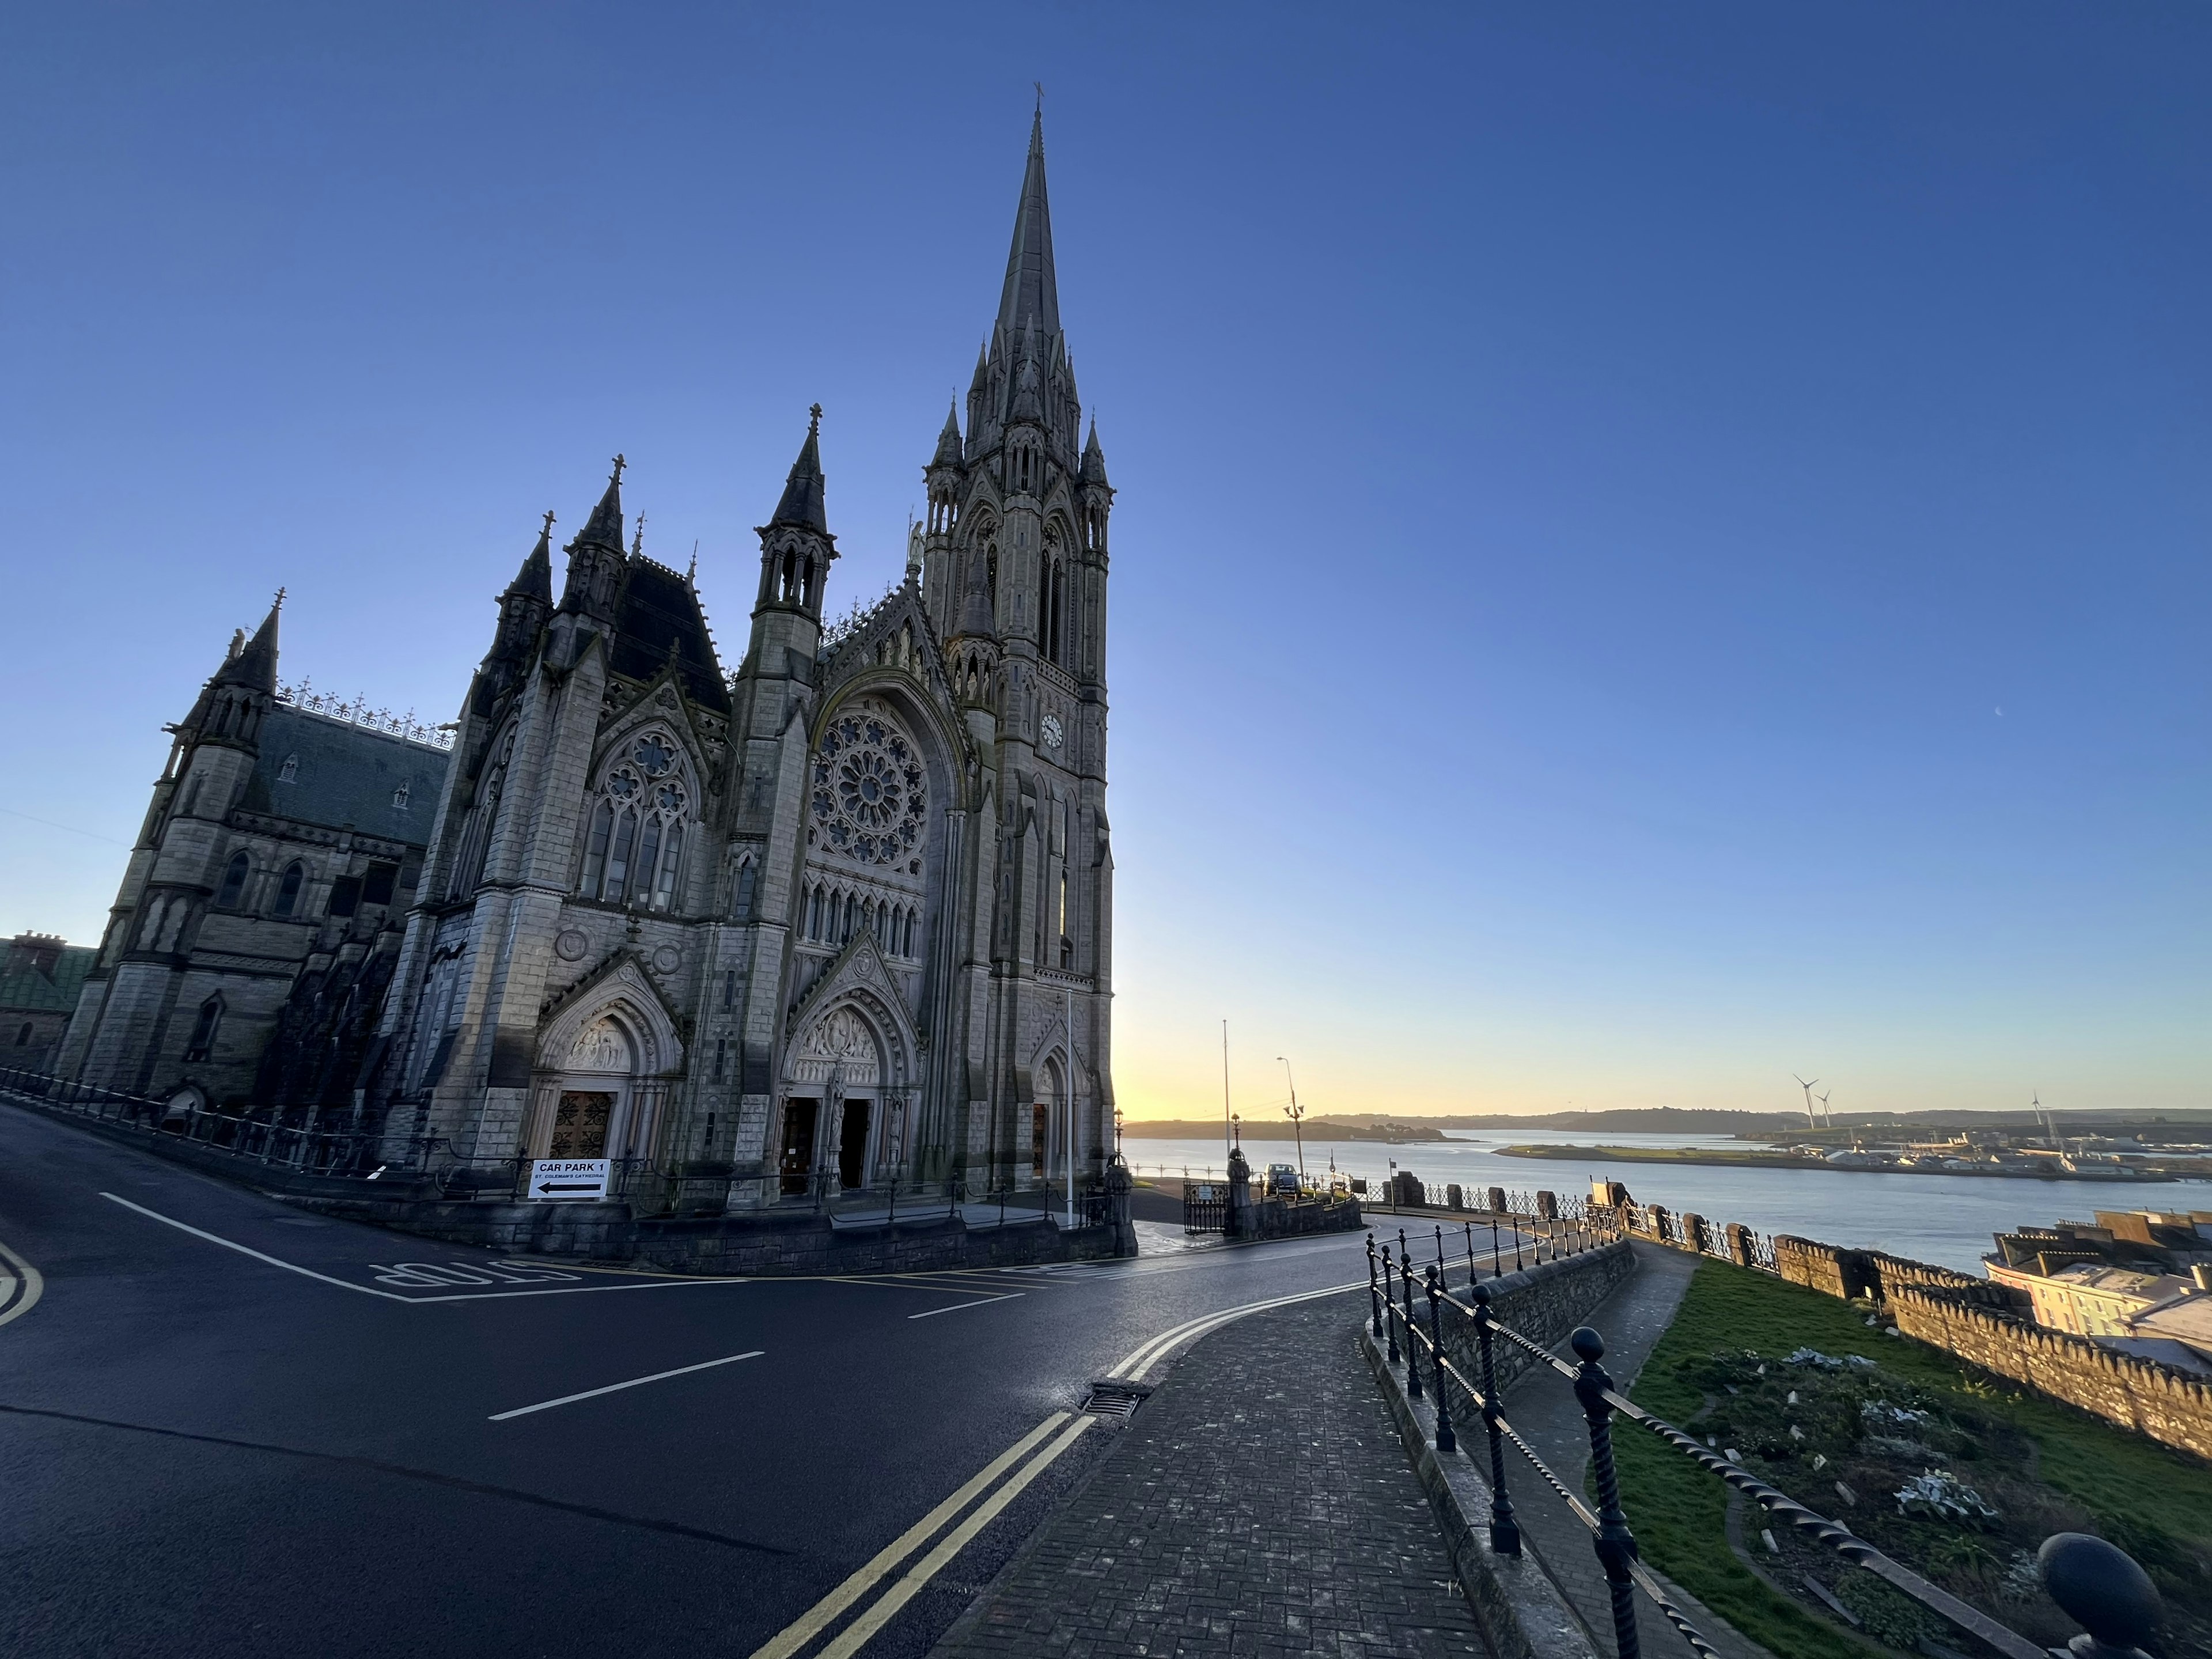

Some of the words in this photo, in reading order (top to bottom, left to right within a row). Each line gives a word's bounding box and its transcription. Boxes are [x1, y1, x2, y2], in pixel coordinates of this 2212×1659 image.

[540, 1164, 562, 1172] CAR
[565, 1163, 595, 1172] PARK
[599, 1163, 604, 1171] 1
[369, 1261, 583, 1287] STOP
